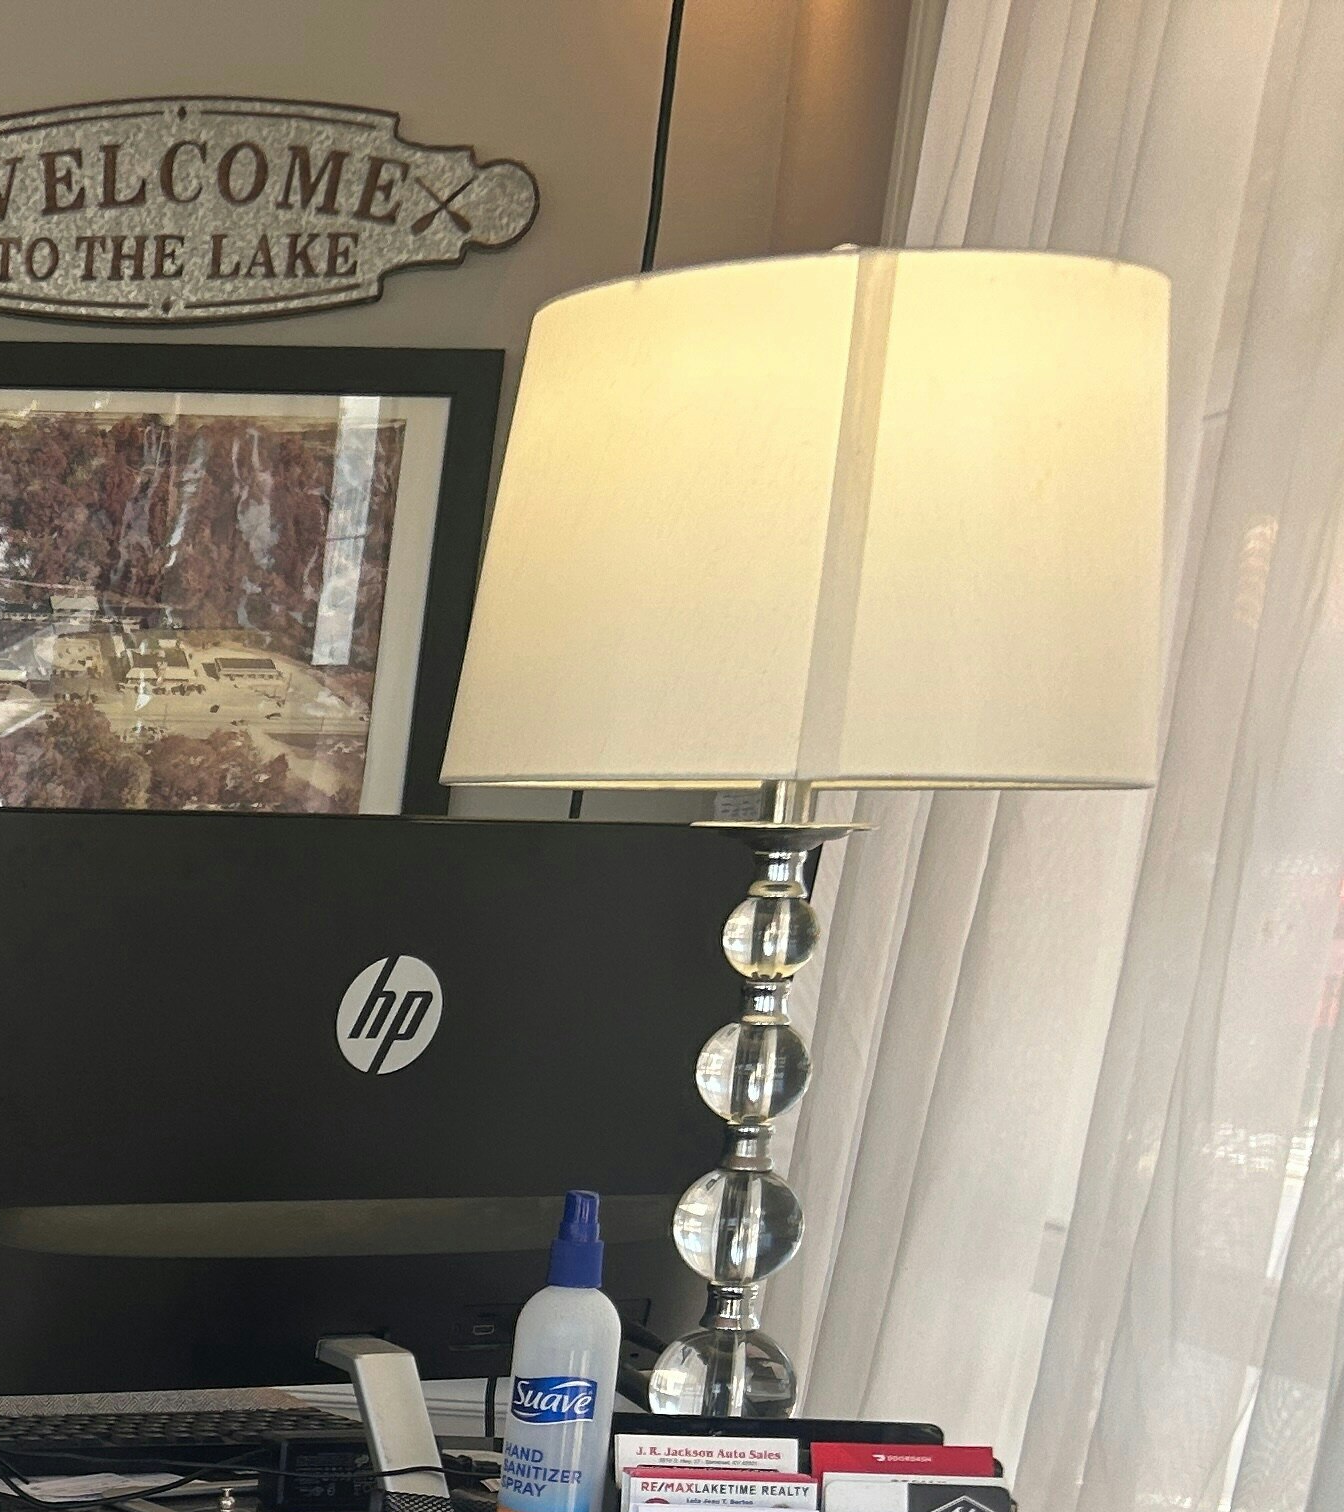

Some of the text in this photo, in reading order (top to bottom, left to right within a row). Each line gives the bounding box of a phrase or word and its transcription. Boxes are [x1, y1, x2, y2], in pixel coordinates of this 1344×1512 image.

[75, 235, 186, 282] THE
[206, 232, 359, 279] LAKE
[346, 955, 434, 1074] hp
[514, 1380, 592, 1415] Suave
[504, 1442, 543, 1463] HAND
[636, 1447, 781, 1460] J. R. Jackson Auto Sales
[504, 1462, 582, 1484] SANITIZER
[501, 1476, 546, 1497] SPRAY
[641, 1482, 810, 1497] RE/MAX LAKETIME REALTY
